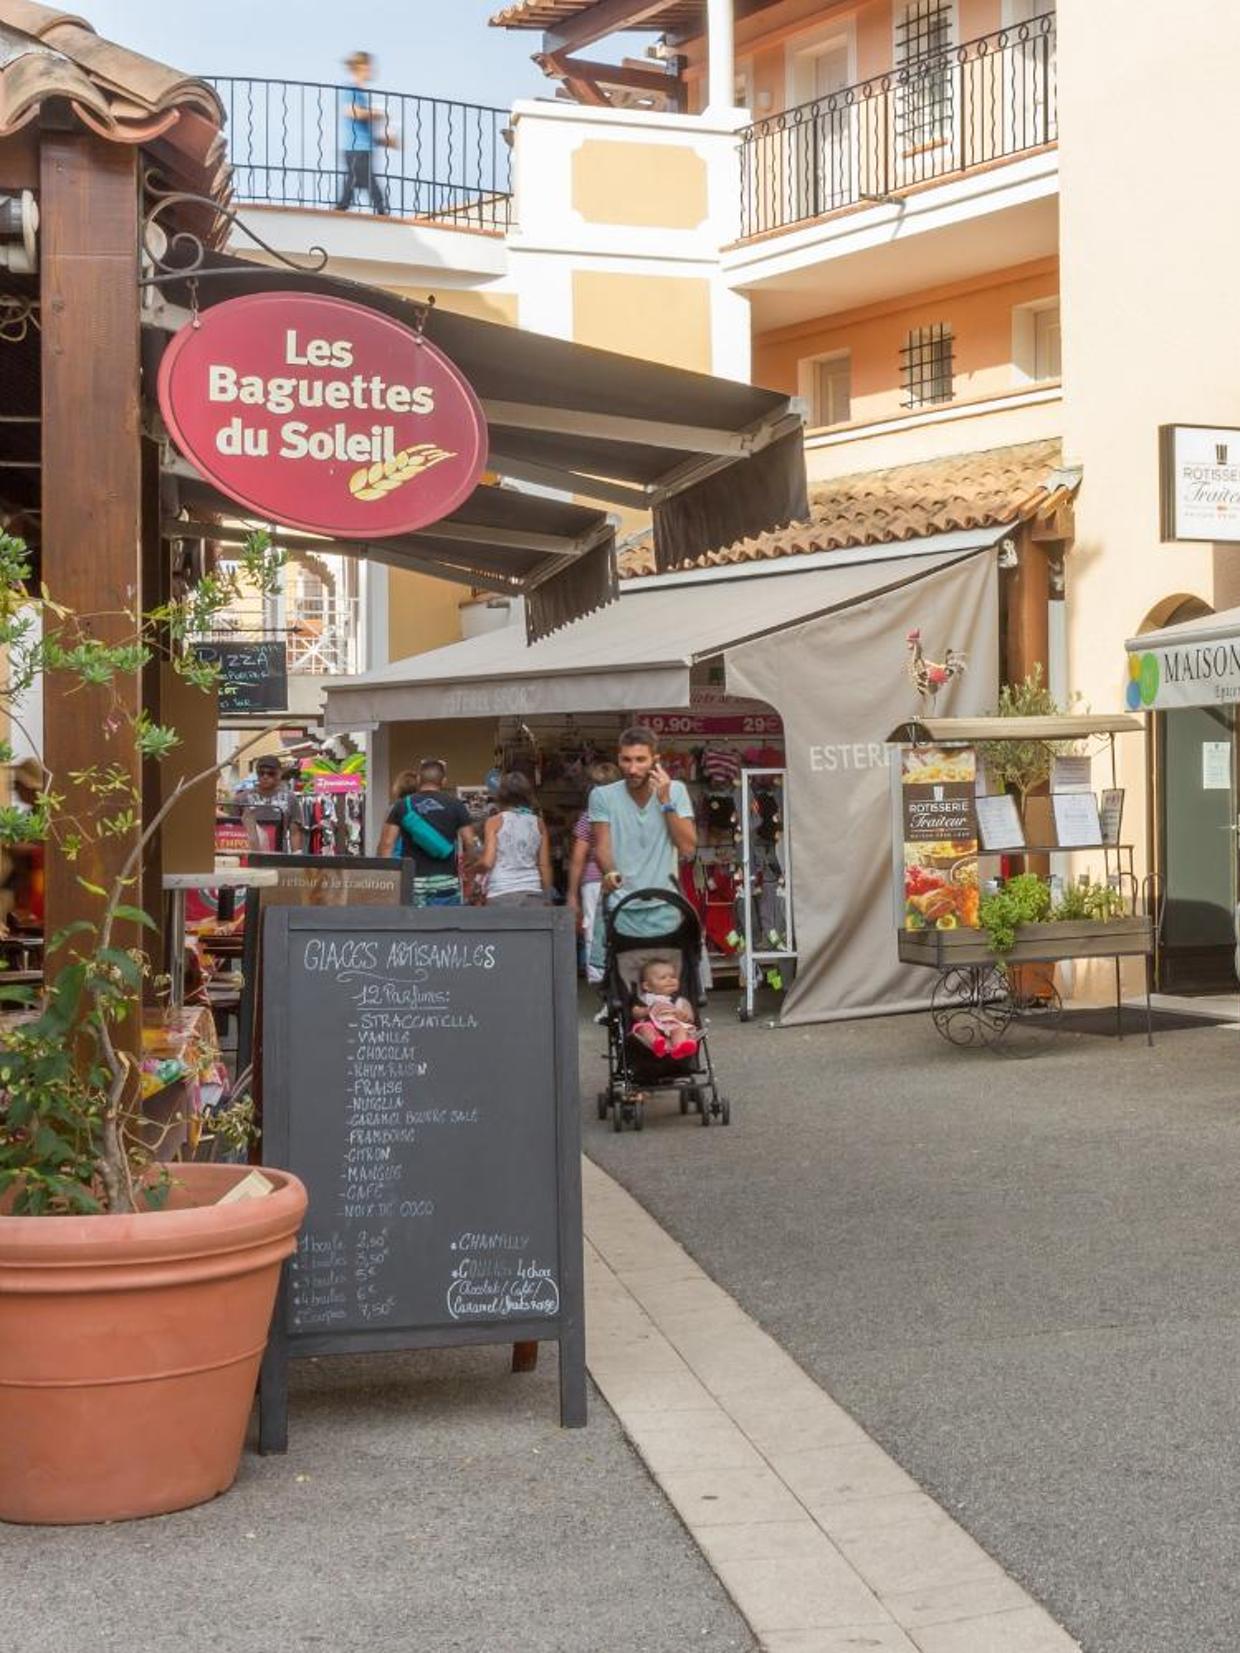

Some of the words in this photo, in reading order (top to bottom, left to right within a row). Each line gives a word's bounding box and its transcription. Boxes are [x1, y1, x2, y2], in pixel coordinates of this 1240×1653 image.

[286, 329, 354, 368] Les
[209, 365, 435, 414] Baguettes
[216, 417, 269, 456] du
[279, 421, 397, 462] Soleil
[910, 813, 967, 828] Traiteur
[343, 877, 395, 891] tradition
[304, 939, 378, 970] GLACES
[387, 941, 495, 968] ARTISANALES
